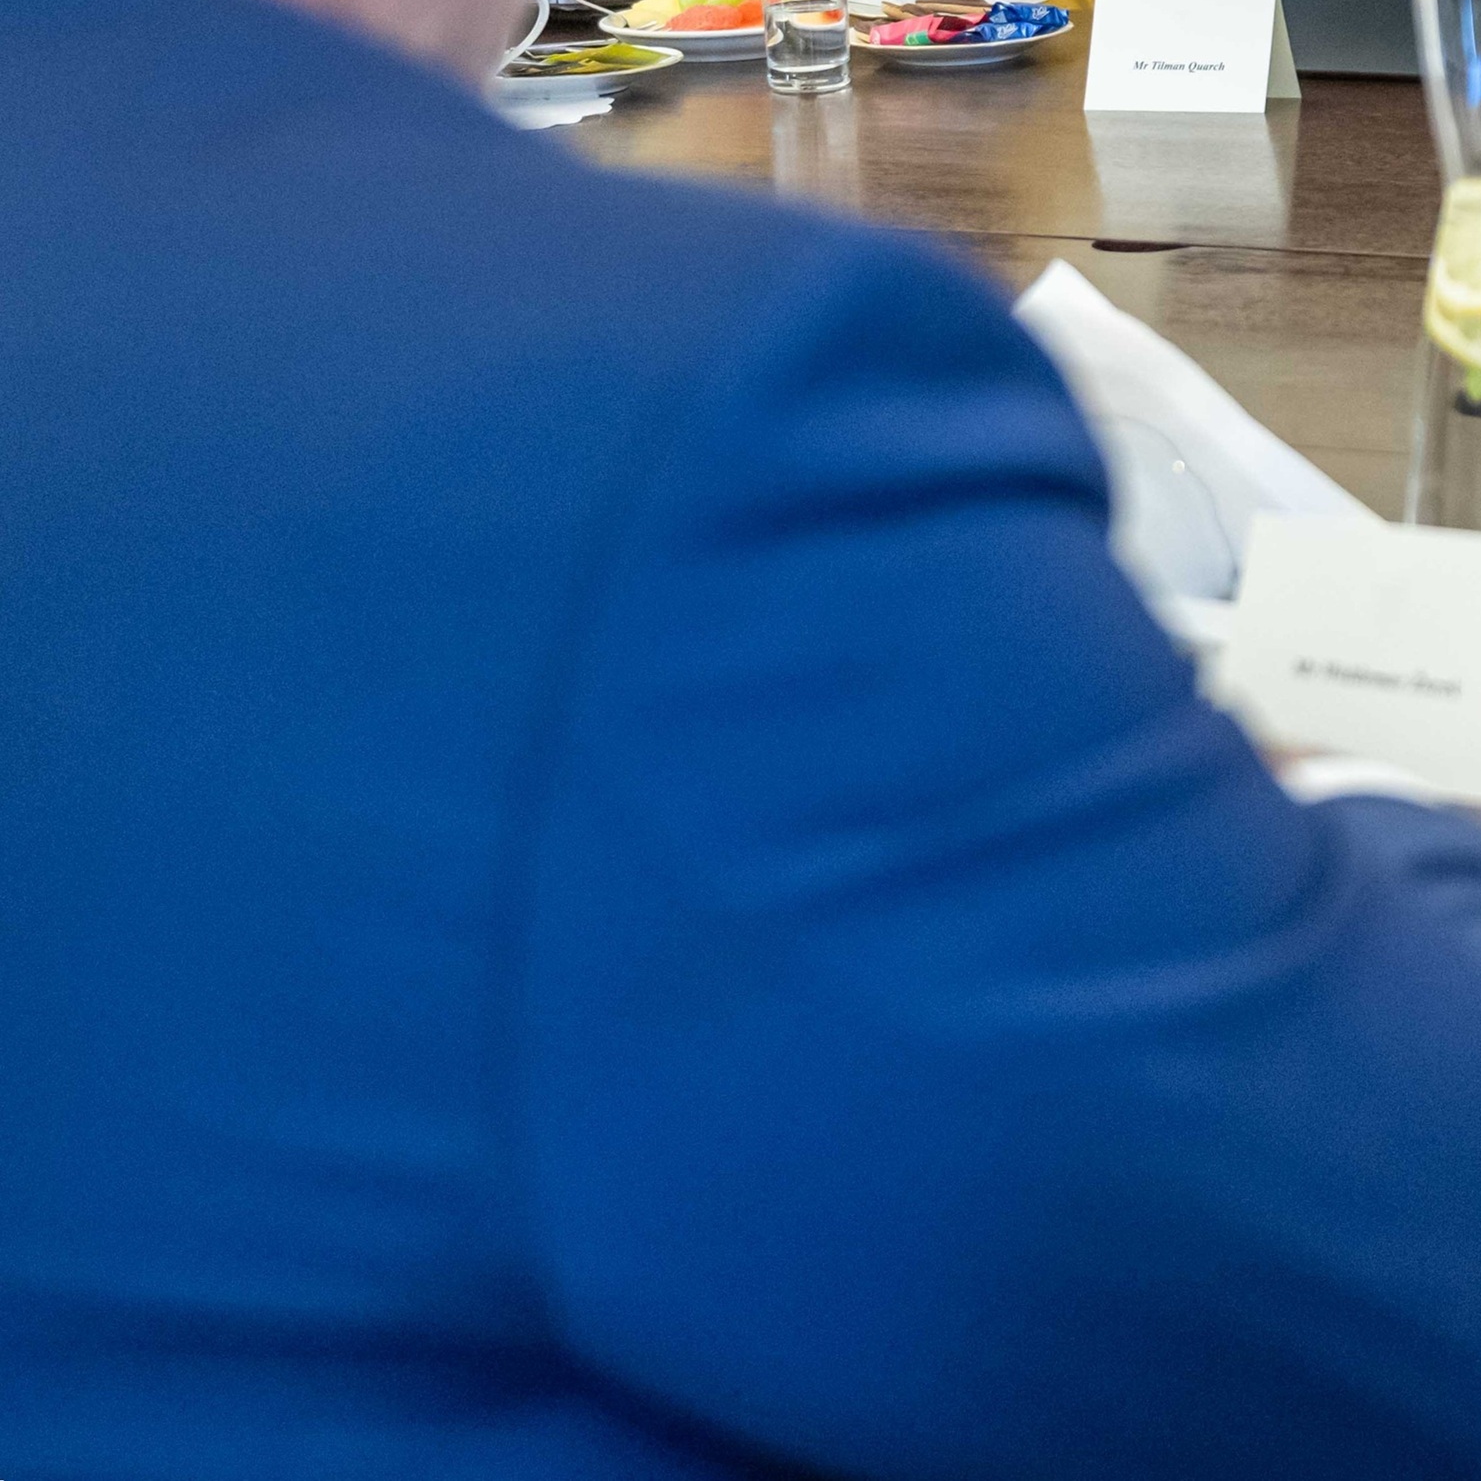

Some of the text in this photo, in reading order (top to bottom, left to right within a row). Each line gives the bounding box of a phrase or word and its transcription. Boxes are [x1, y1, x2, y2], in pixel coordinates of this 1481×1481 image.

[1133, 60, 1226, 74] Mr Tilman Quarch
